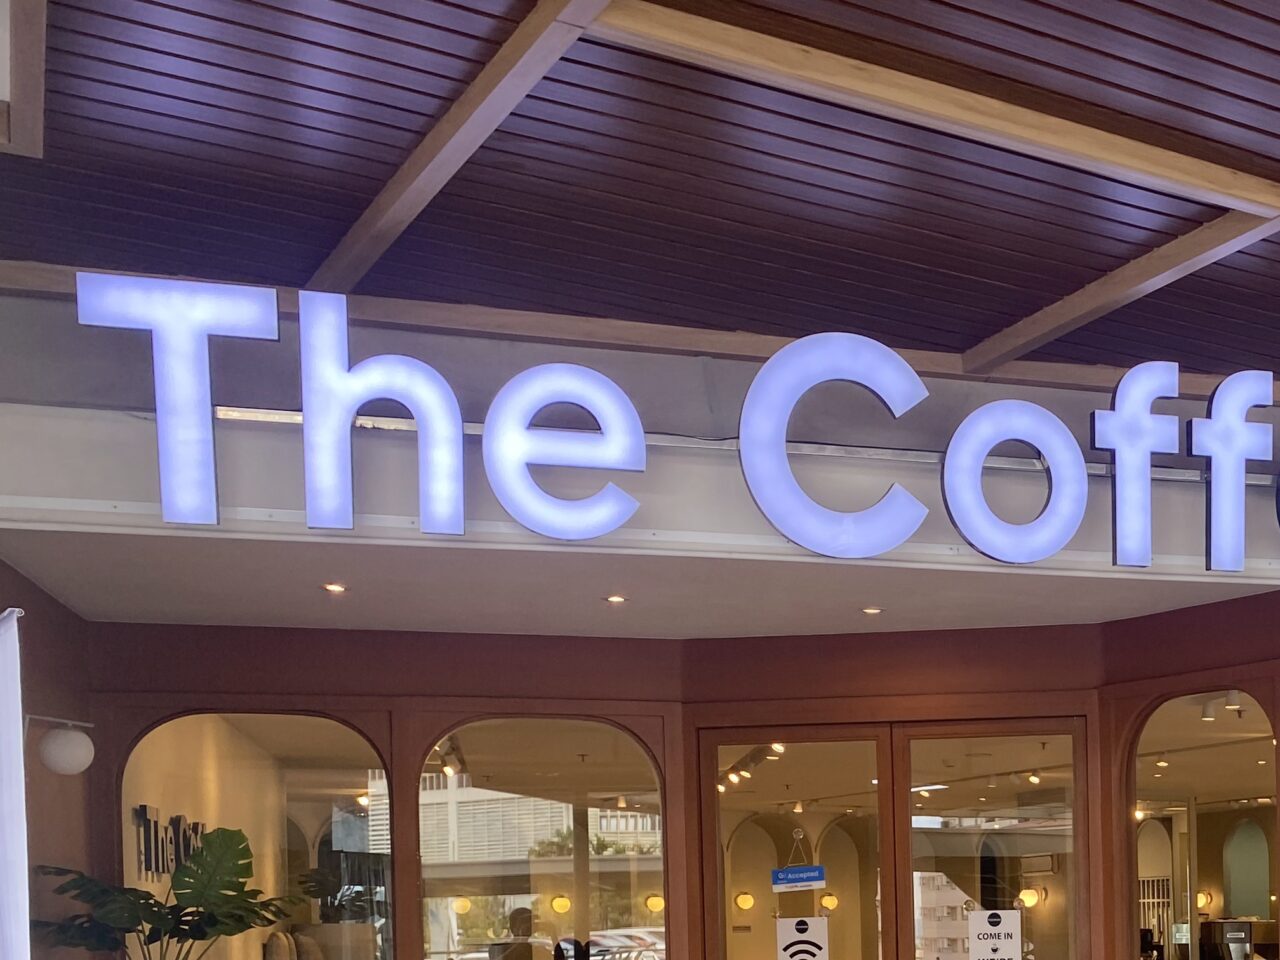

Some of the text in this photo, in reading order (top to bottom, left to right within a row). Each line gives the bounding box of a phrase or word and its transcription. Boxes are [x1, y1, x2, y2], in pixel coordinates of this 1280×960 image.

[76, 272, 646, 540] The
[977, 932, 1013, 940] COME IN
